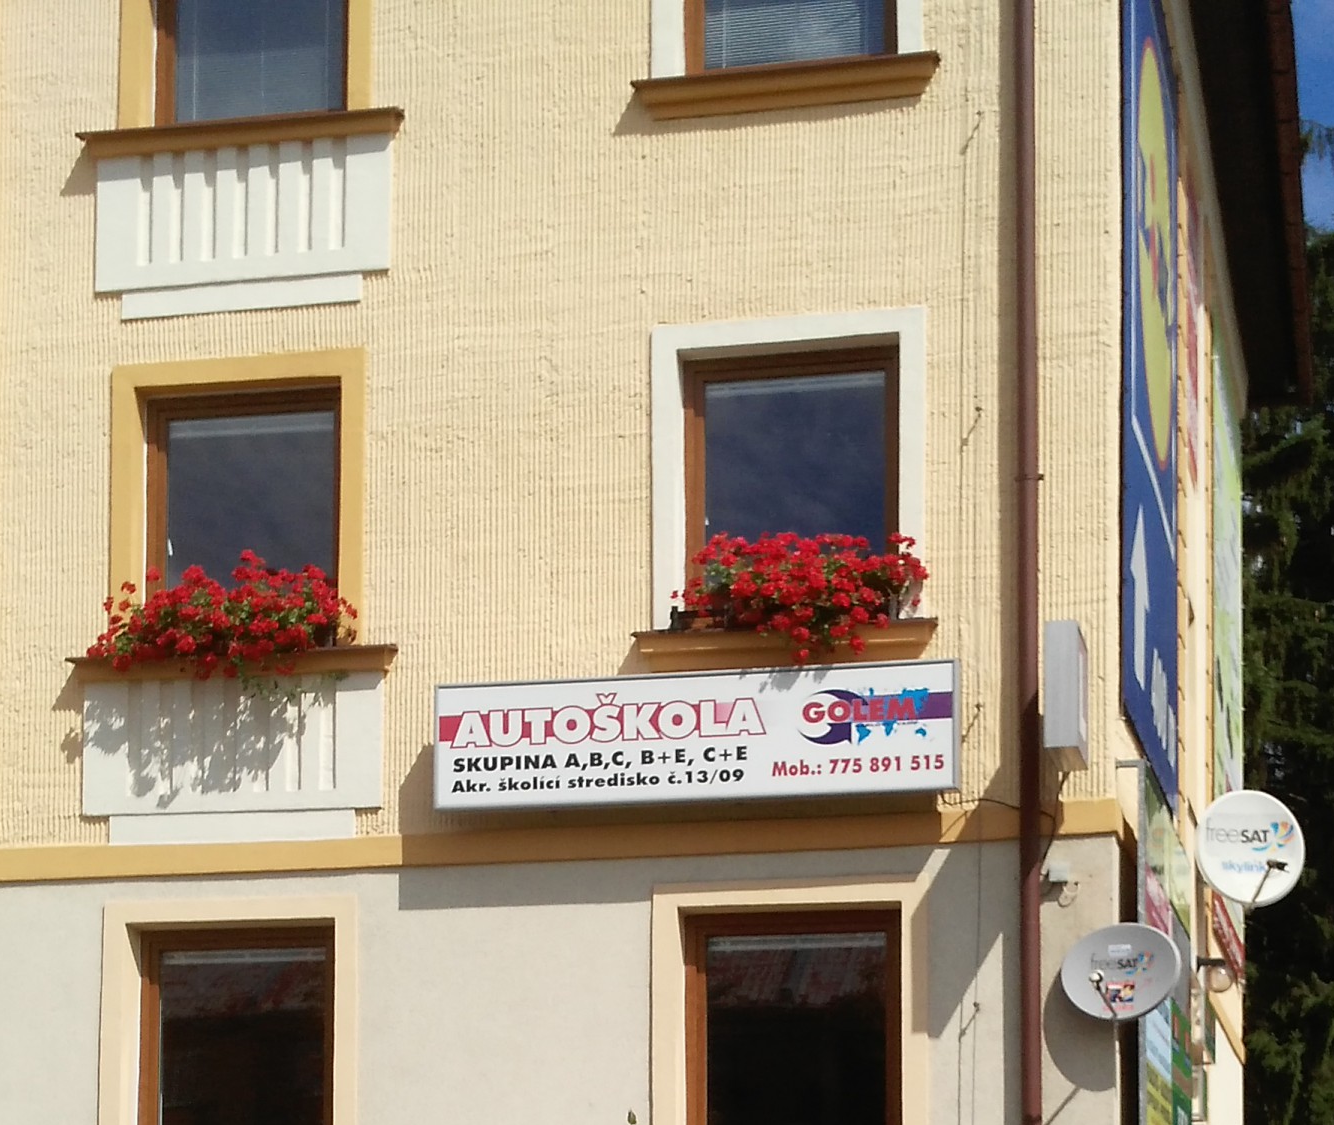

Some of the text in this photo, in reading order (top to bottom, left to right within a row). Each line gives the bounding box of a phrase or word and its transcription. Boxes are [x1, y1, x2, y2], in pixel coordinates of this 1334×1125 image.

[450, 693, 766, 748] AUTOŠKOLA
[802, 698, 916, 723] GOLEM
[453, 745, 748, 773] SKUPINA A,B,C, B+E, C+E
[772, 754, 945, 777] Mob.: 775 891 515
[451, 768, 745, 793] Akr. školící stredisko č.13/09
